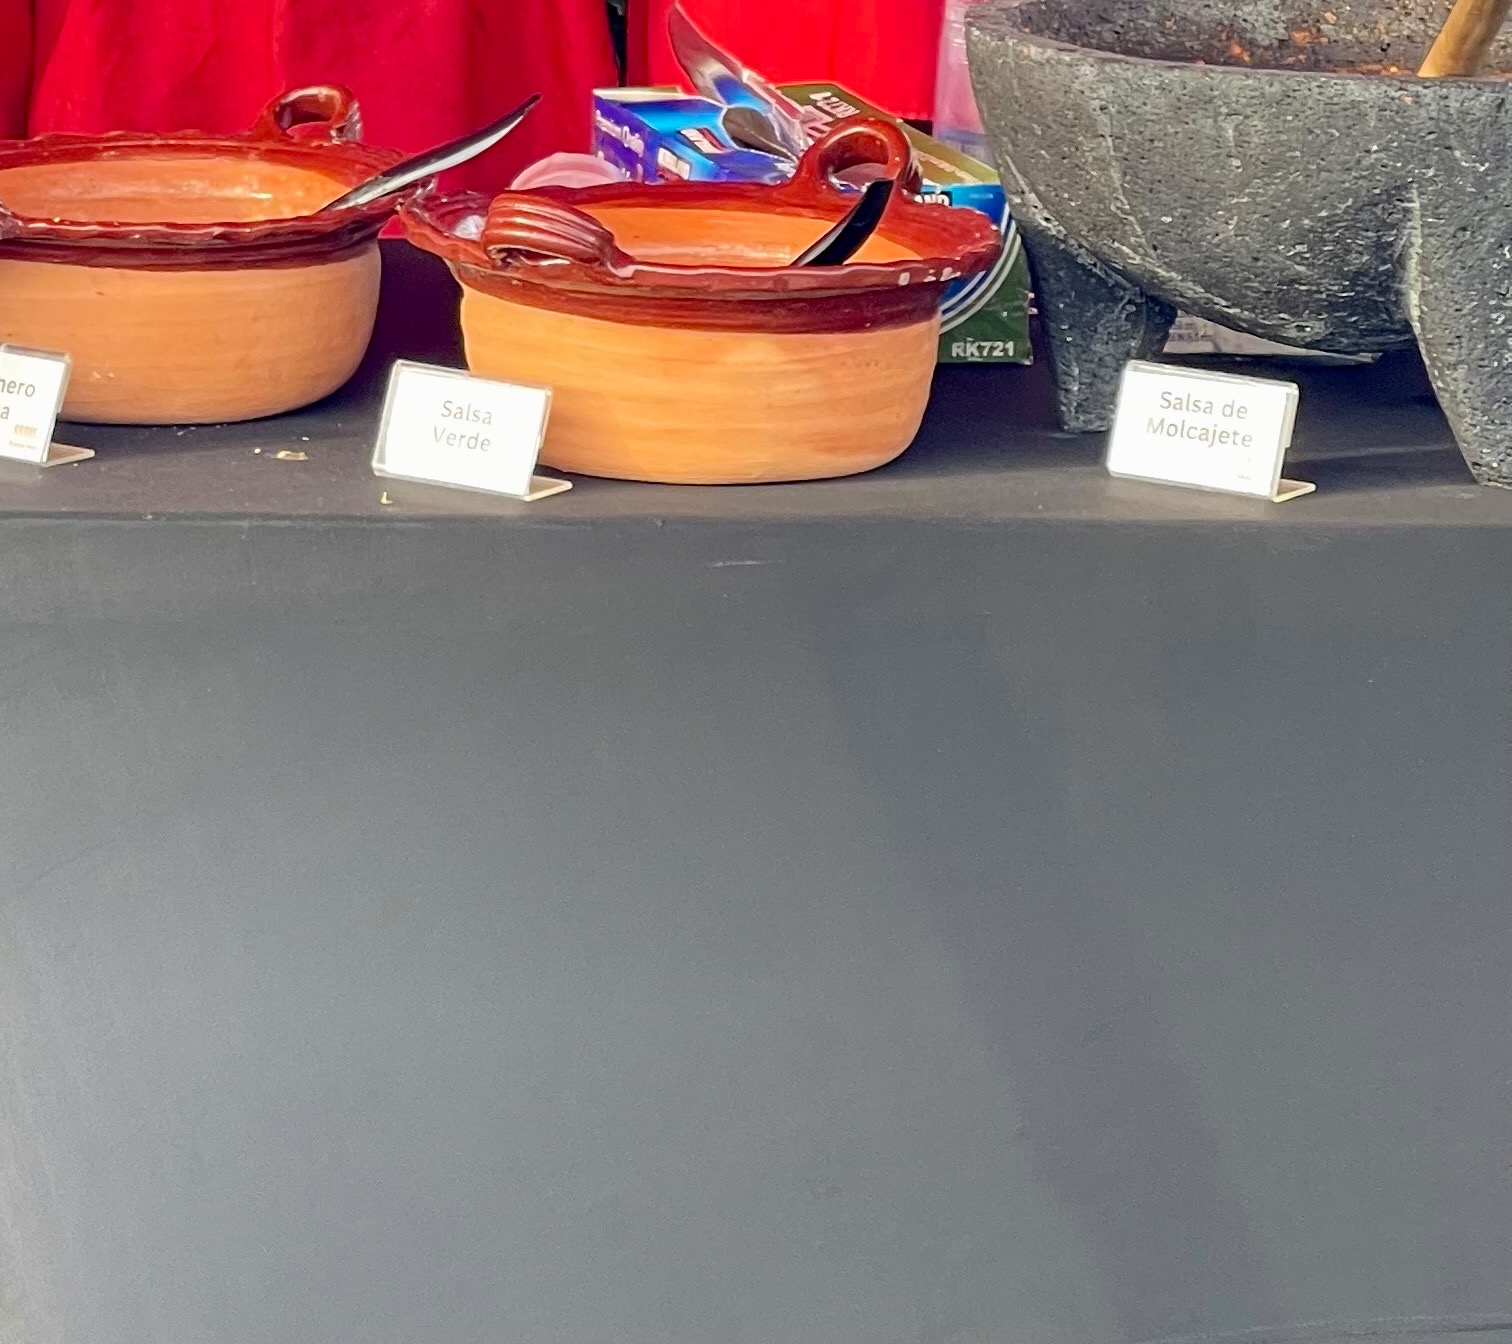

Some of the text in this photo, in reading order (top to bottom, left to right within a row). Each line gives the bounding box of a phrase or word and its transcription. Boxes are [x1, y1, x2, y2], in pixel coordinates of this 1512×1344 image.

[951, 340, 1015, 358] RK721
[440, 400, 493, 426] Salsa
[1159, 390, 1249, 420] Salsa de
[432, 425, 492, 453] Verde
[1145, 416, 1254, 449] Molcajete
